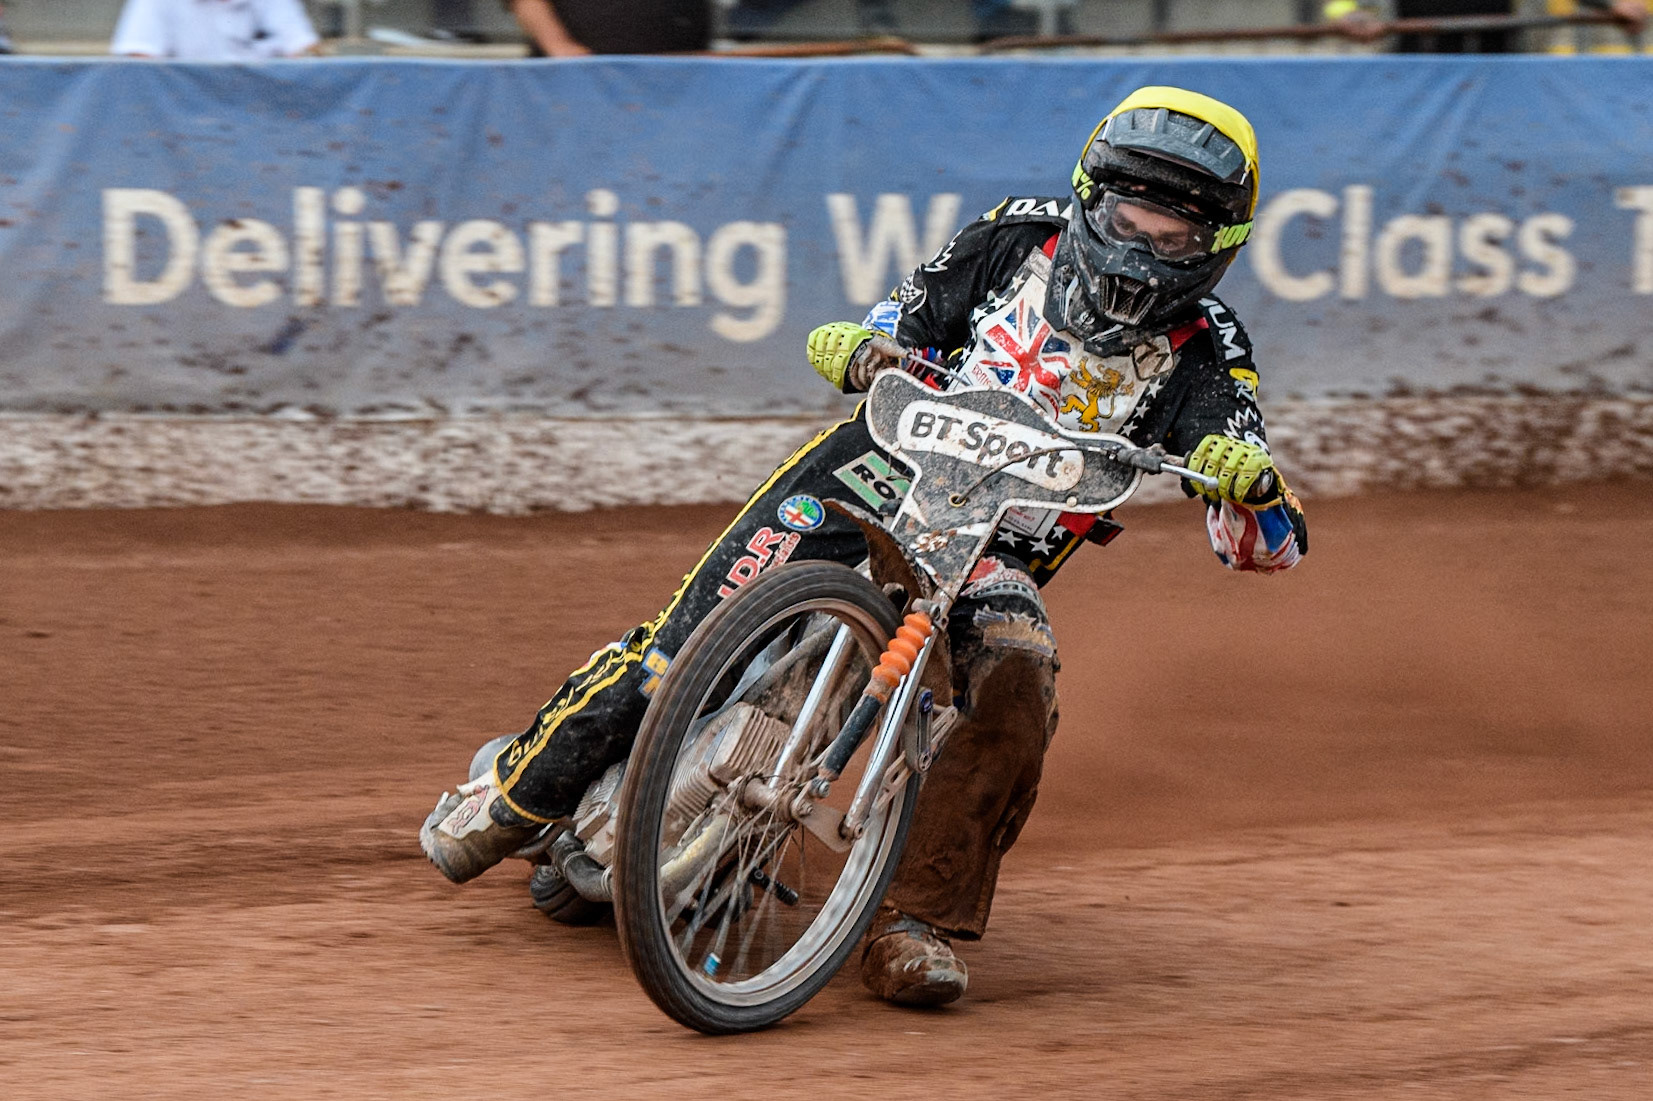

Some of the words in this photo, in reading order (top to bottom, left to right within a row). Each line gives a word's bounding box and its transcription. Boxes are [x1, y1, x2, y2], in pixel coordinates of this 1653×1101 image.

[102, 187, 788, 342] Delivering
[1251, 185, 1577, 300] Class
[909, 411, 962, 442] BT
[960, 420, 1065, 480] Sport
